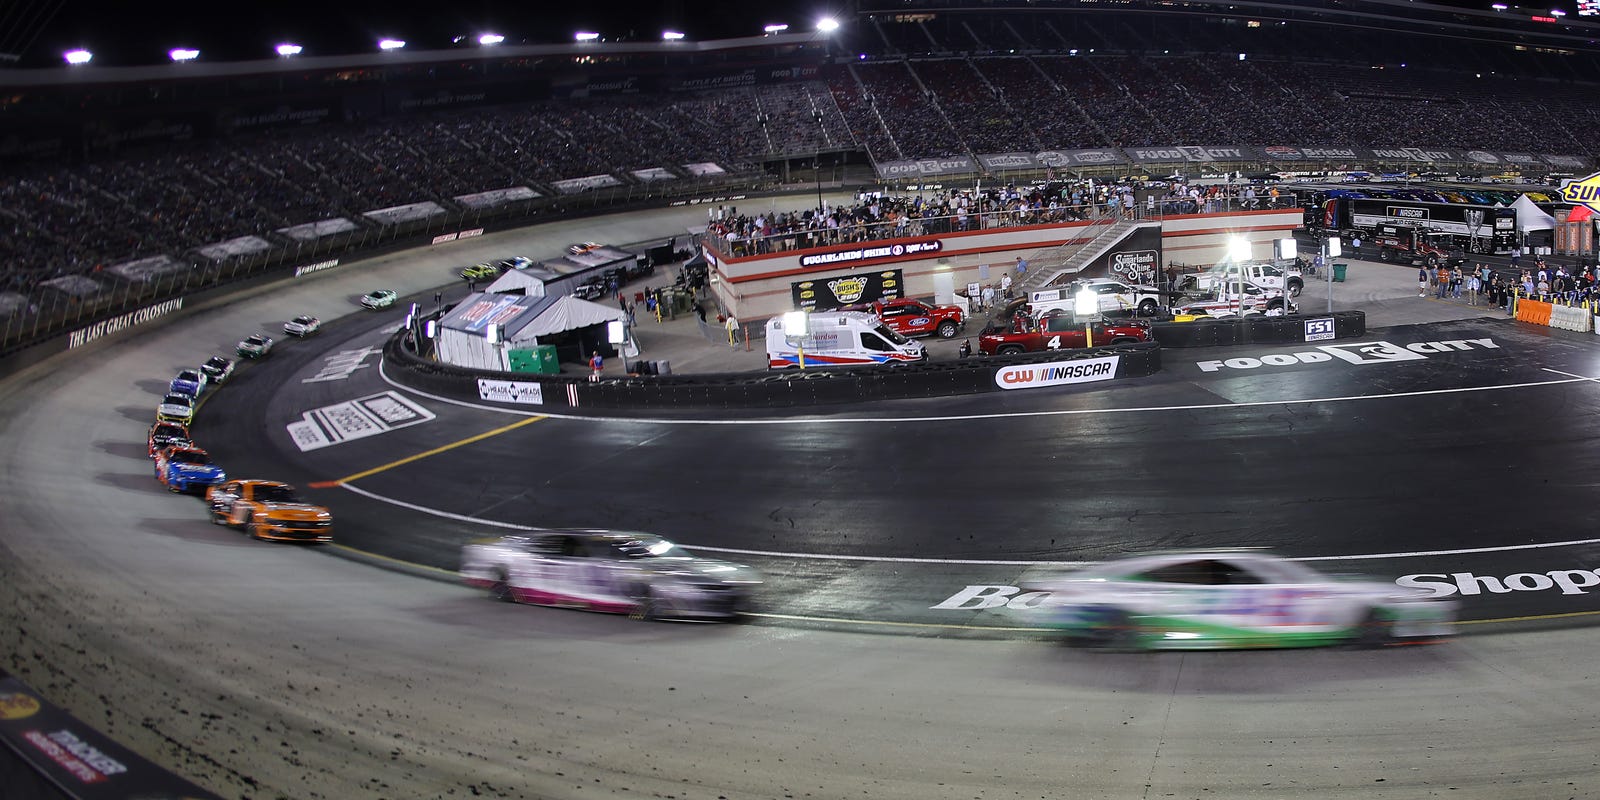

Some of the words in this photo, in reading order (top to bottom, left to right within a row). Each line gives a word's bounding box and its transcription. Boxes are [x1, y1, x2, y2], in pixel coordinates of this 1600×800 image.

[1134, 150, 1182, 160] FOOD
[1206, 148, 1242, 158] CITY
[1301, 147, 1356, 157] Bristol
[1370, 149, 1404, 158] FOOD
[1424, 151, 1453, 160] CITY
[882, 163, 920, 174] FOOD
[939, 160, 968, 169] CITY
[1399, 209, 1424, 218] NASCAR
[803, 249, 862, 265] SUGARLANDS
[863, 246, 892, 258] SHINE
[1113, 253, 1154, 272] Sugarlands
[1127, 267, 1152, 281] Shine
[836, 283, 862, 293] BUSH'S
[69, 329, 86, 350] THE
[86, 320, 107, 343] LAST
[106, 310, 134, 335] GREAT
[133, 296, 184, 326] COLOSSEUM
[1307, 321, 1332, 333] FS1
[1046, 335, 1060, 349] 4
[1196, 350, 1333, 372] FOOD
[1406, 338, 1500, 353] CITY
[1001, 370, 1032, 384] CW
[1052, 362, 1110, 379] NASCAR
[1395, 570, 1600, 599] Shop
[928, 586, 1052, 610] Ba
